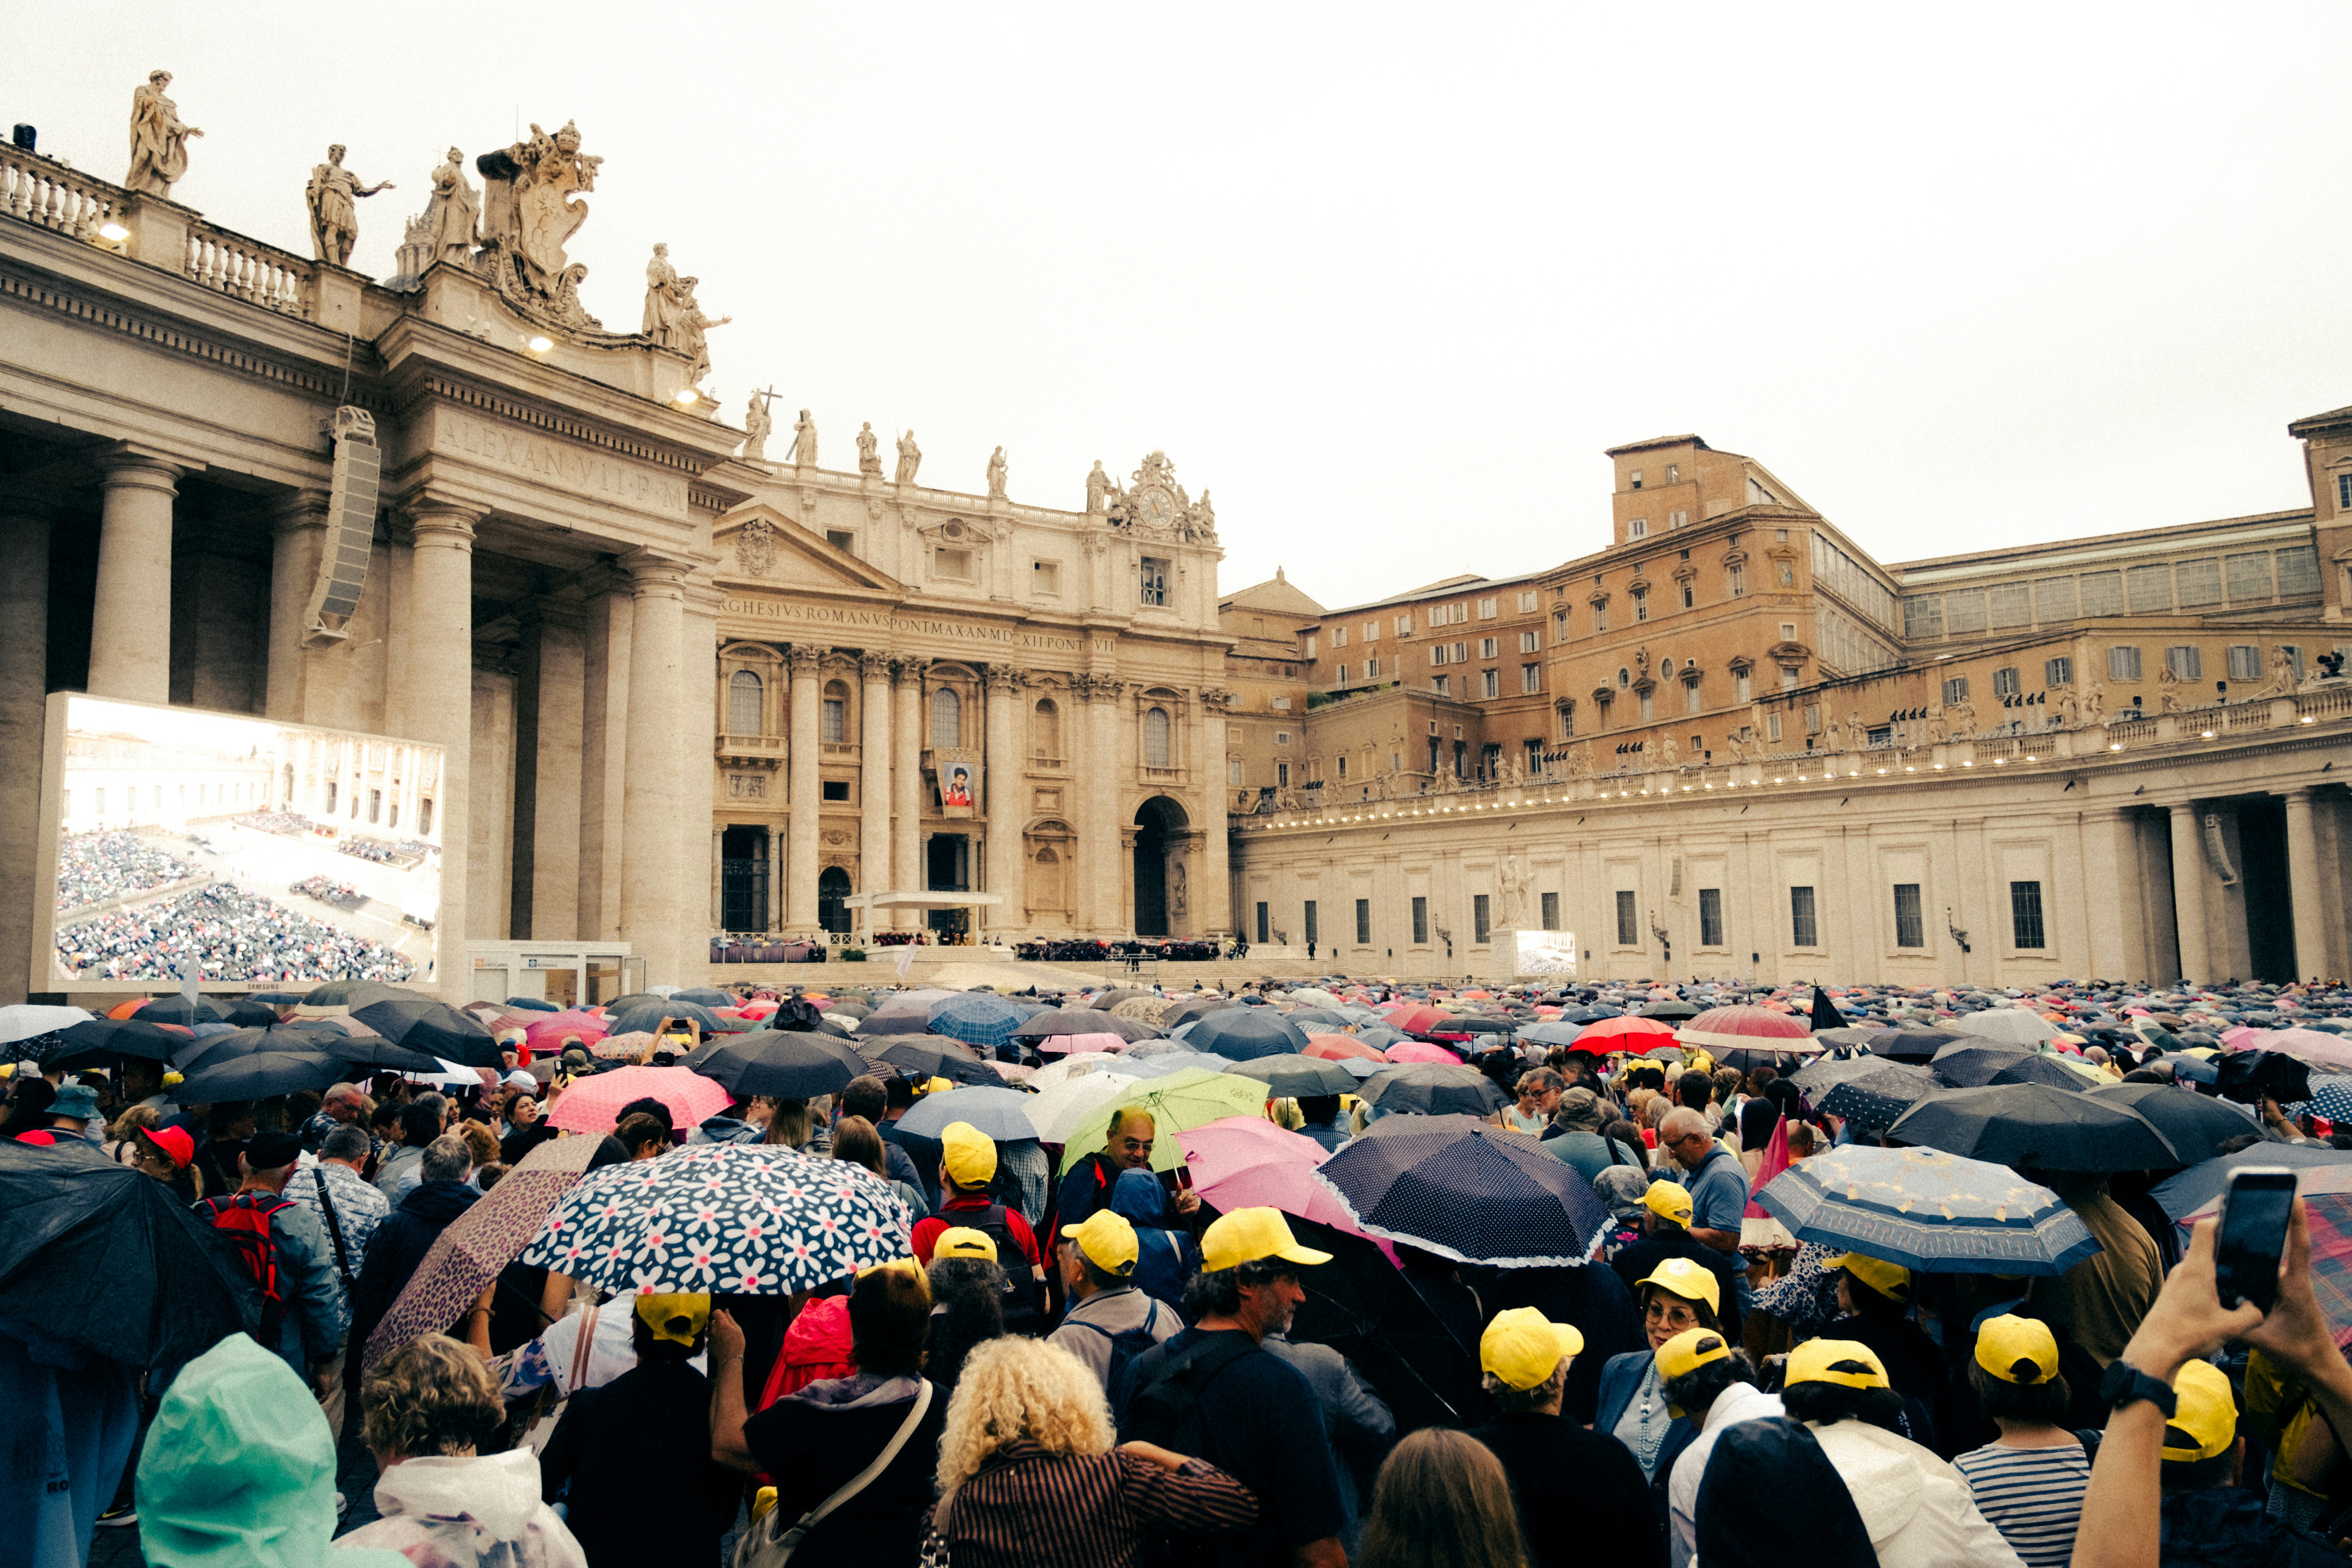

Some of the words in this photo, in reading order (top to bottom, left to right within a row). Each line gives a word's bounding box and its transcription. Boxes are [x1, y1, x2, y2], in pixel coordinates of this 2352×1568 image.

[807, 607, 889, 627] ROMANVS
[1047, 637, 1084, 651] PONT
[1095, 639, 1113, 651] VII
